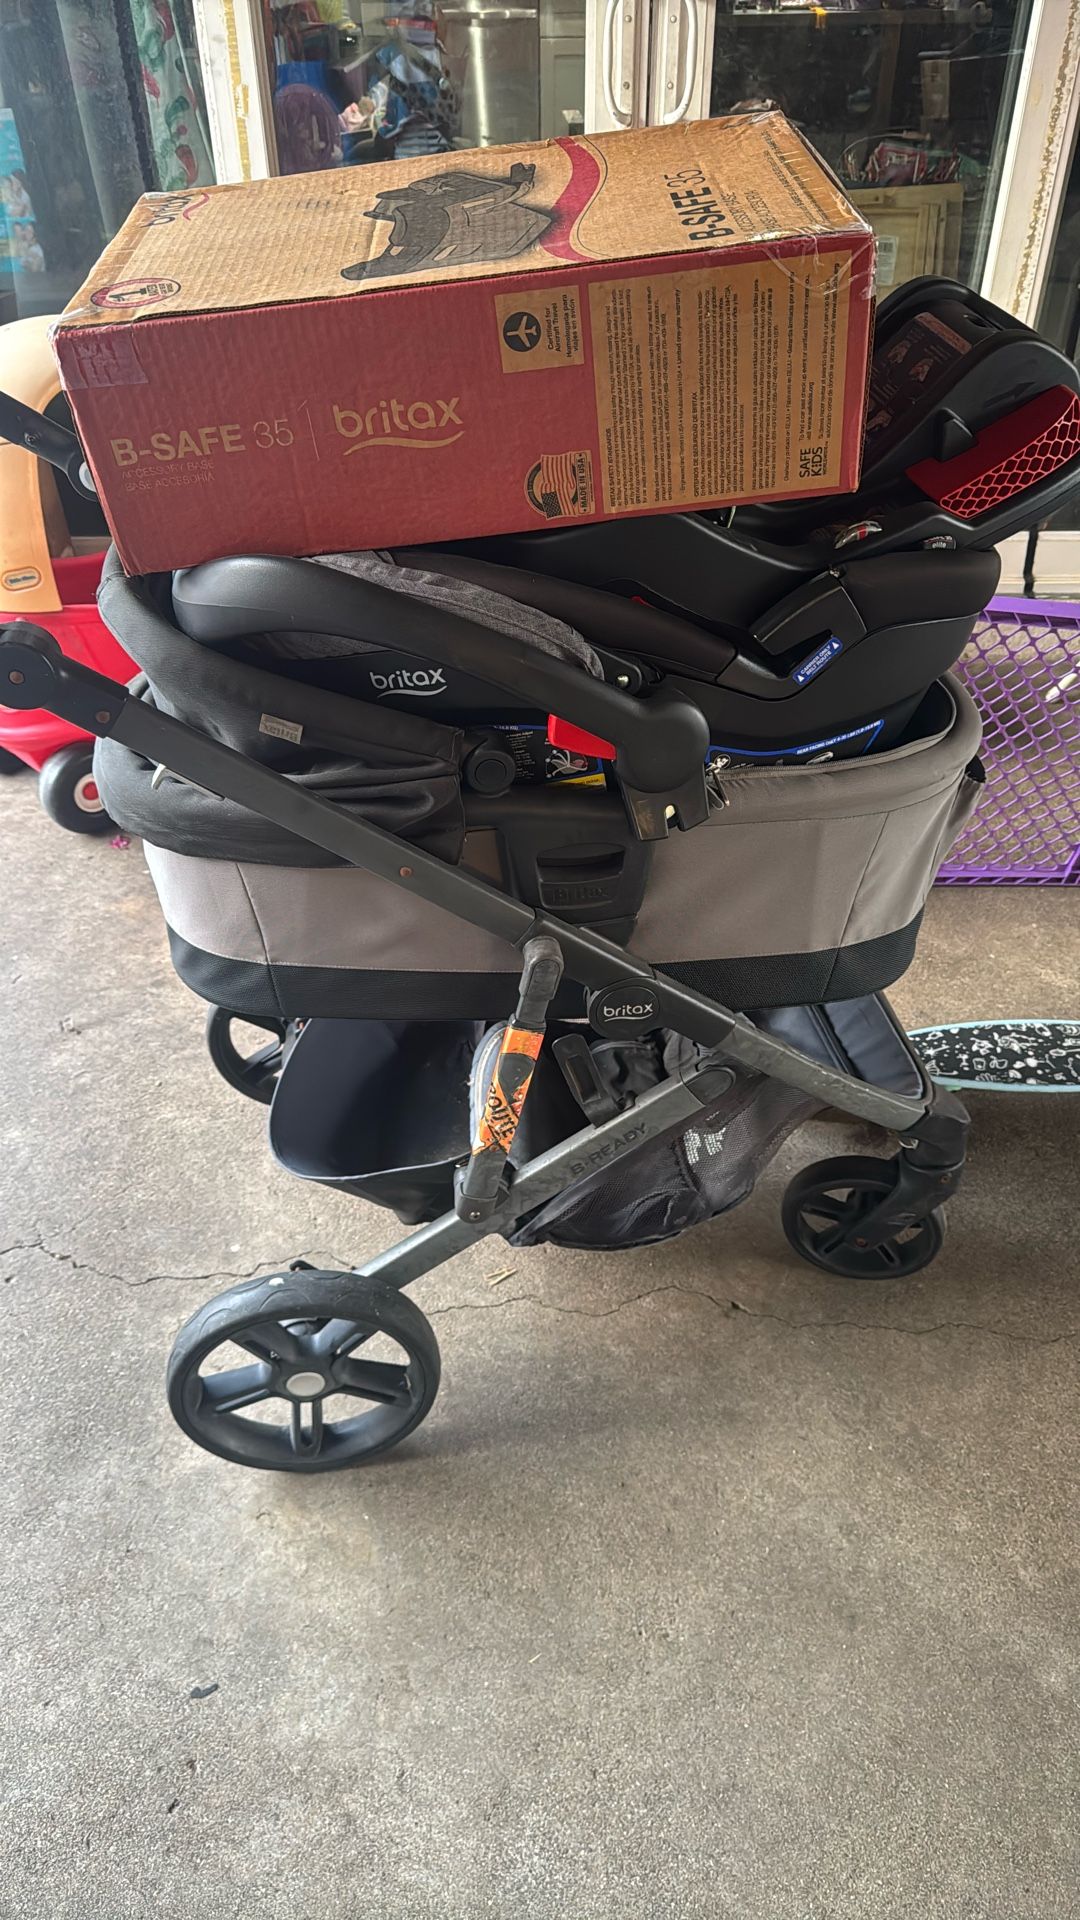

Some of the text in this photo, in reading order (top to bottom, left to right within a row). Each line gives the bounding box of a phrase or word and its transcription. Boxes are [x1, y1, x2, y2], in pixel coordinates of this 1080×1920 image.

[664, 169, 735, 241] B-SAFE 35
[551, 302, 562, 352] Aircraft Travel
[333, 397, 464, 439] britax
[691, 414, 698, 422] DE
[110, 418, 295, 467] B-SAFE 35
[605, 427, 613, 463] STANDARDS
[693, 457, 698, 466] DE
[798, 447, 810, 478] SAFE
[576, 457, 588, 508] MADE IN USA
[800, 655, 820, 675] CARRIER
[818, 644, 832, 658] ONLY
[805, 663, 818, 676] BELT
[815, 650, 832, 667] ROUTE
[369, 668, 447, 690] britax
[603, 1002, 654, 1018] britax
